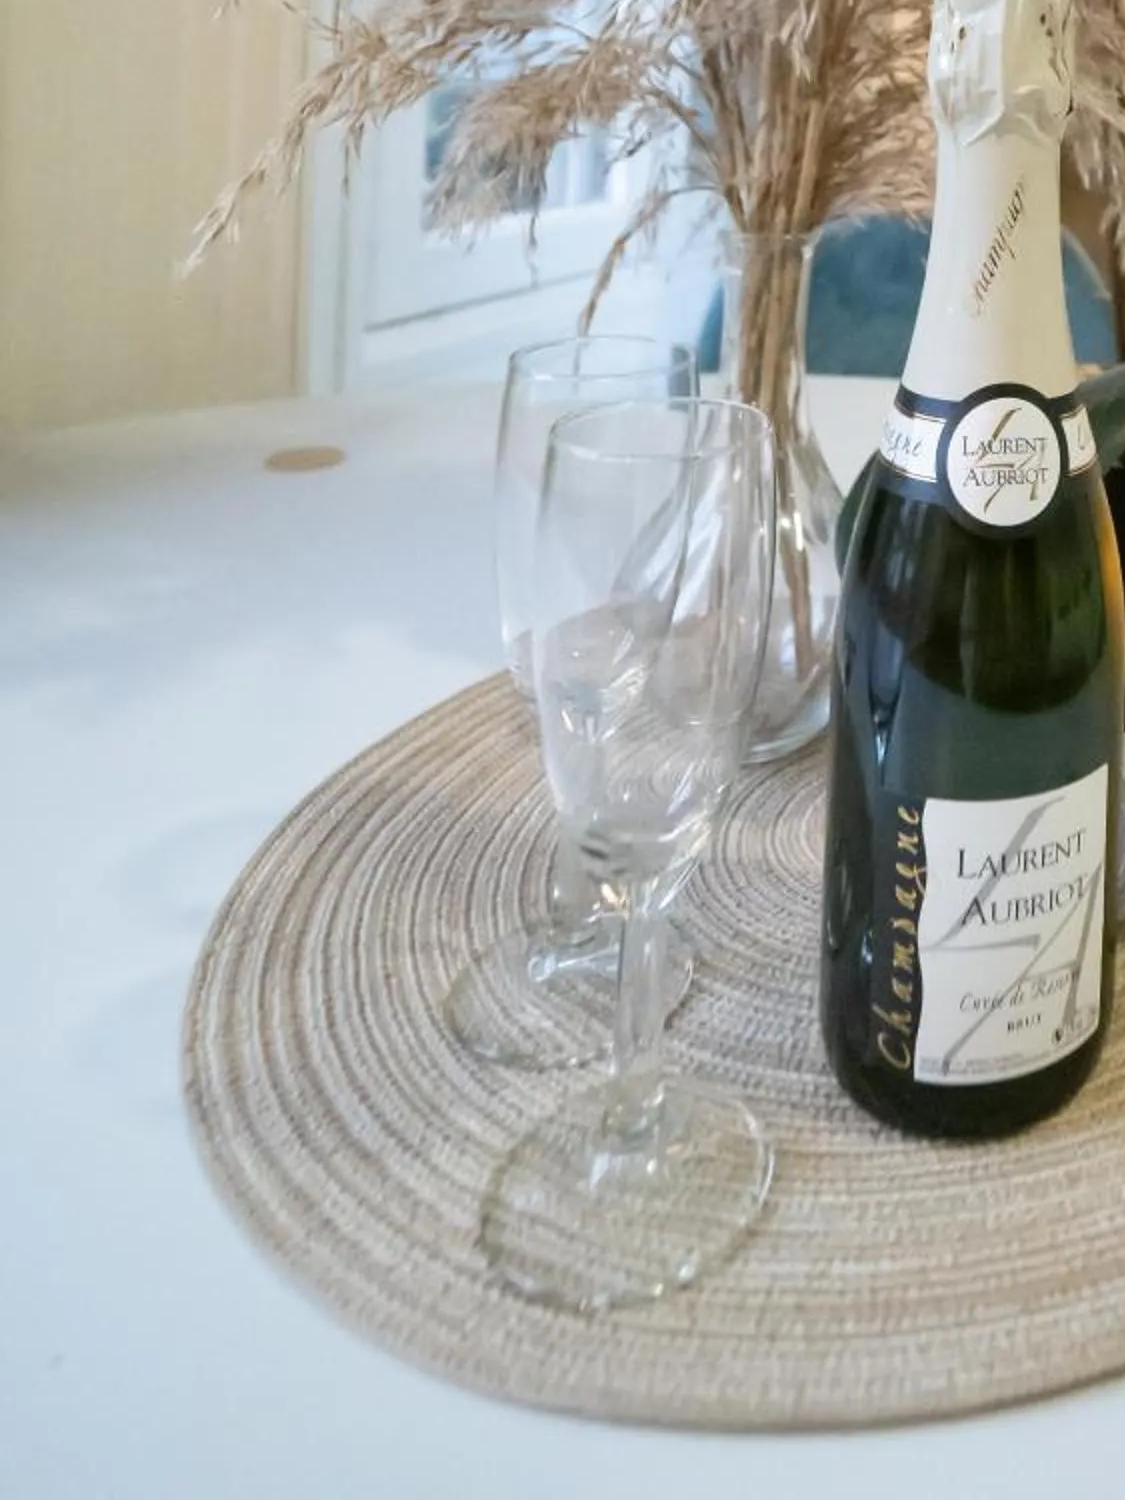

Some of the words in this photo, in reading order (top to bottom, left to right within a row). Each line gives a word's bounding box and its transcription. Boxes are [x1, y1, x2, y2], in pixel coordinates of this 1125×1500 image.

[961, 435, 1049, 457] LAURENT
[962, 466, 1049, 488] AUBRIOT
[957, 830, 1087, 879] LAURENT
[961, 873, 1089, 927] AUBRIOT
[873, 805, 927, 1071] Champagne
